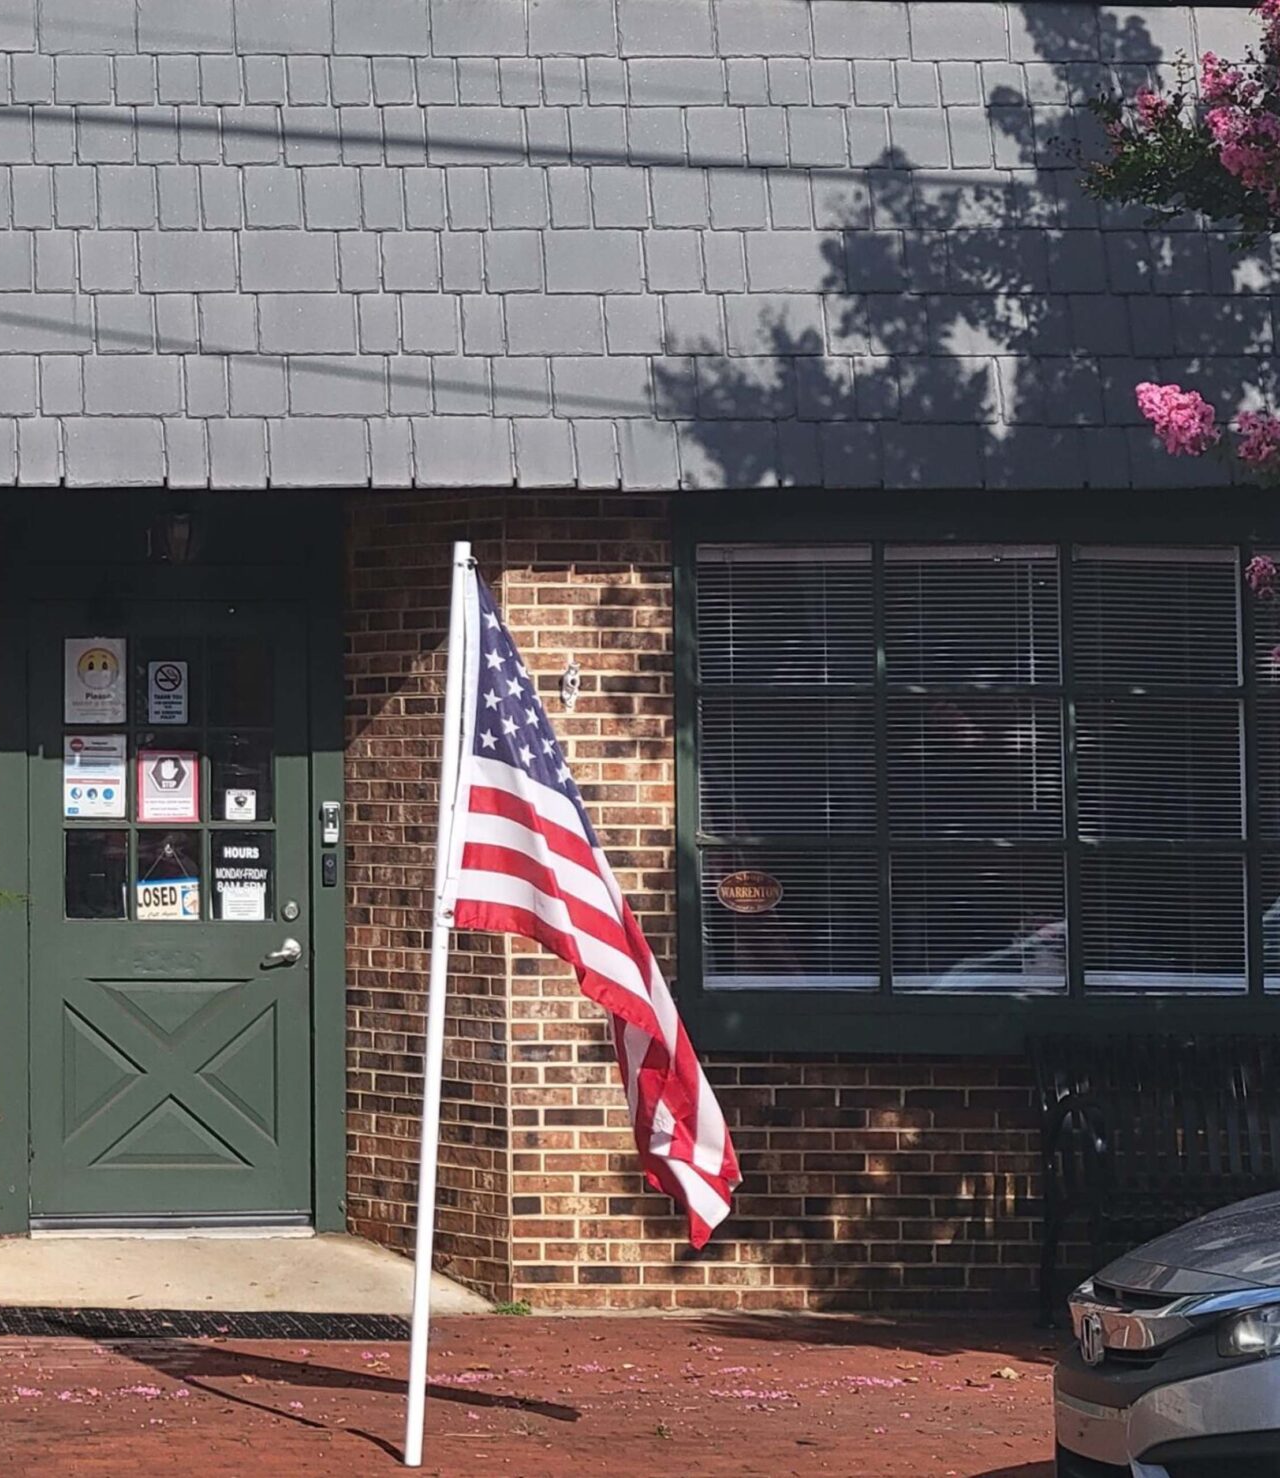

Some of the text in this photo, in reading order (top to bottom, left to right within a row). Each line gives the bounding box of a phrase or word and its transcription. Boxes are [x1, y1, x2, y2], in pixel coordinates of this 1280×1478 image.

[223, 846, 259, 859] HOURS
[215, 867, 268, 880] MONDAY-FRIDAY
[721, 886, 780, 898] WARRENTON
